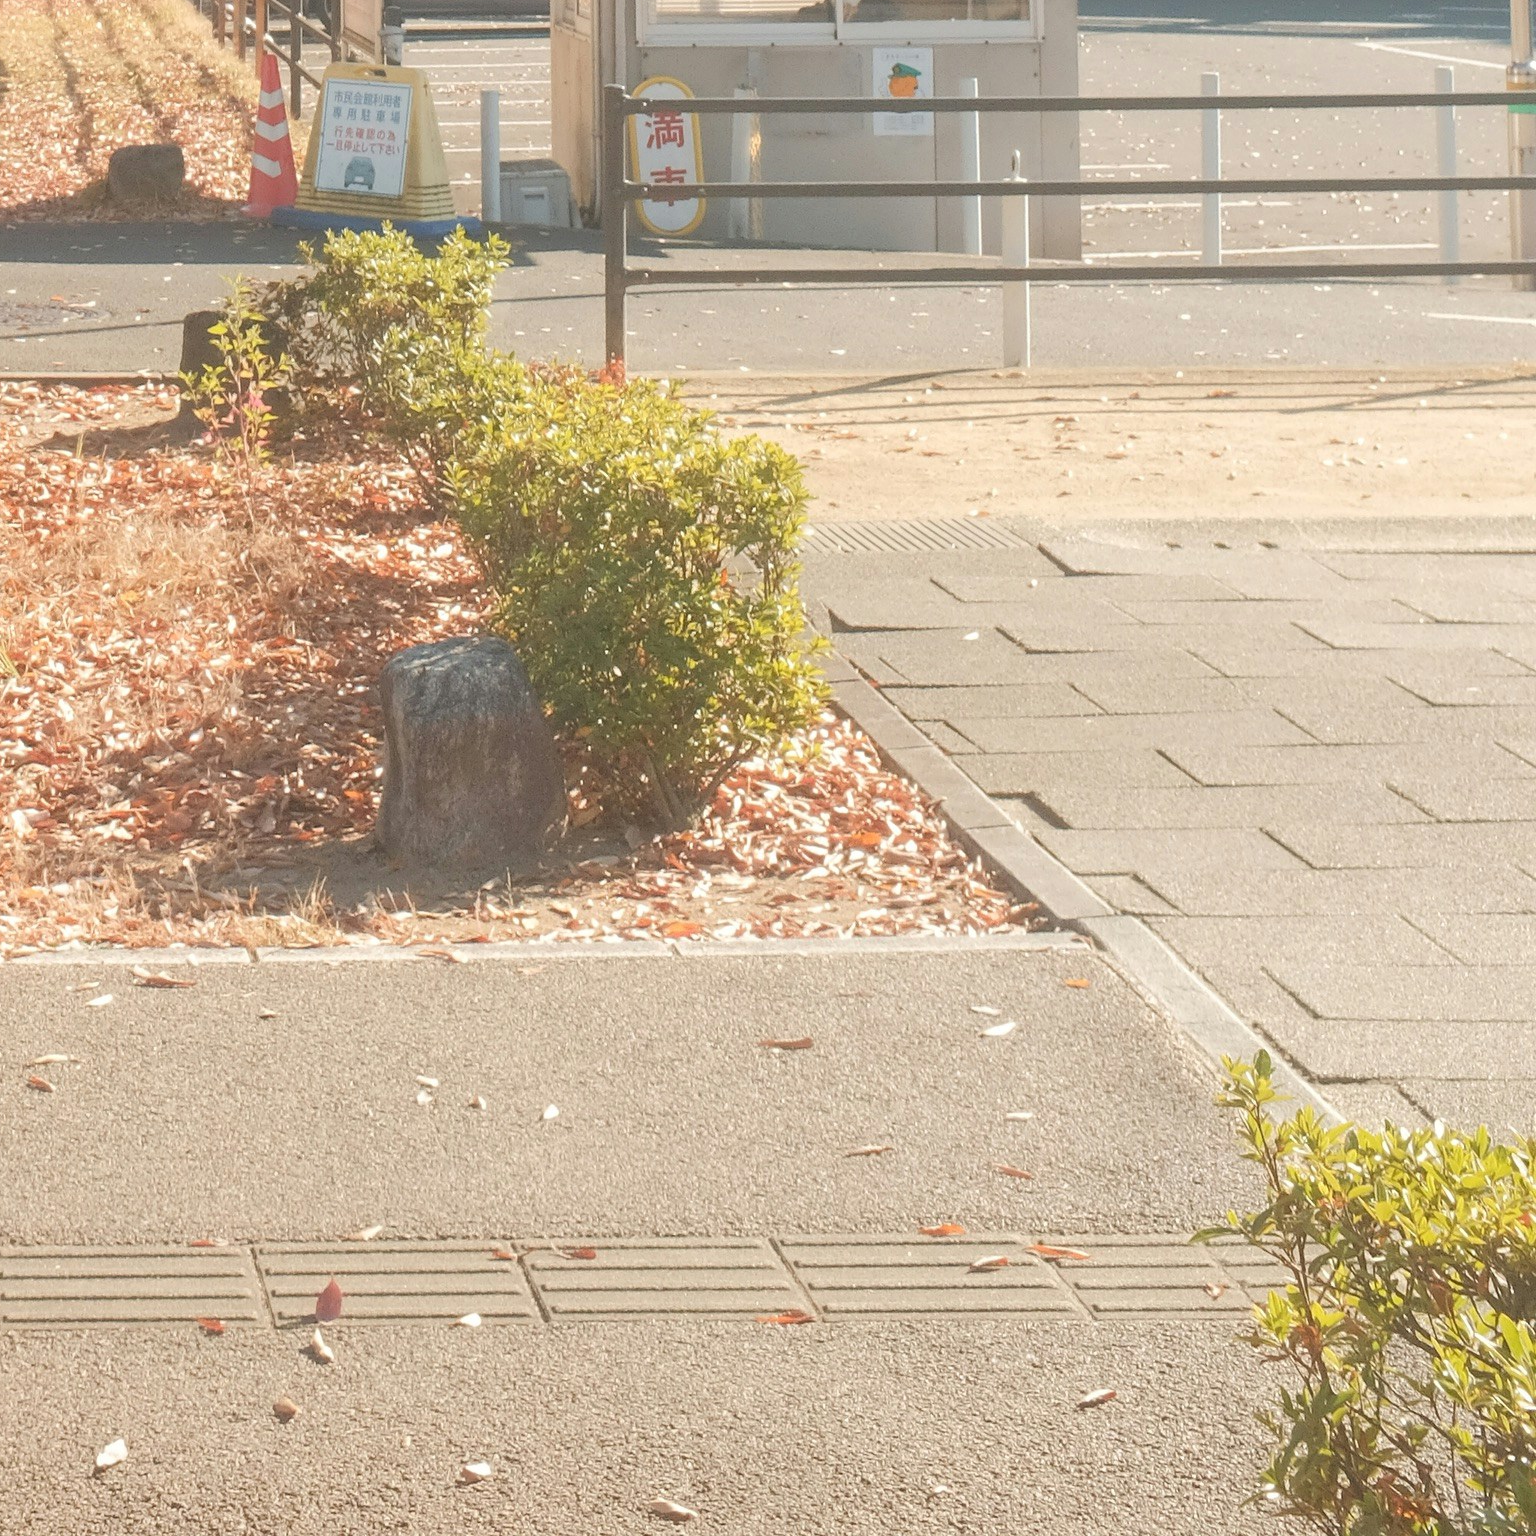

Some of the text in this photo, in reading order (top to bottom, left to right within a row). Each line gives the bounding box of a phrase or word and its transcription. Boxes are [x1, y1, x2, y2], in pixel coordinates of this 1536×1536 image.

[335, 91, 401, 108] 市民会館利用者
[333, 108, 401, 124] 専用駐車場
[335, 126, 395, 141] 行先確認の為
[326, 140, 400, 155] 一旦停止して下さい
